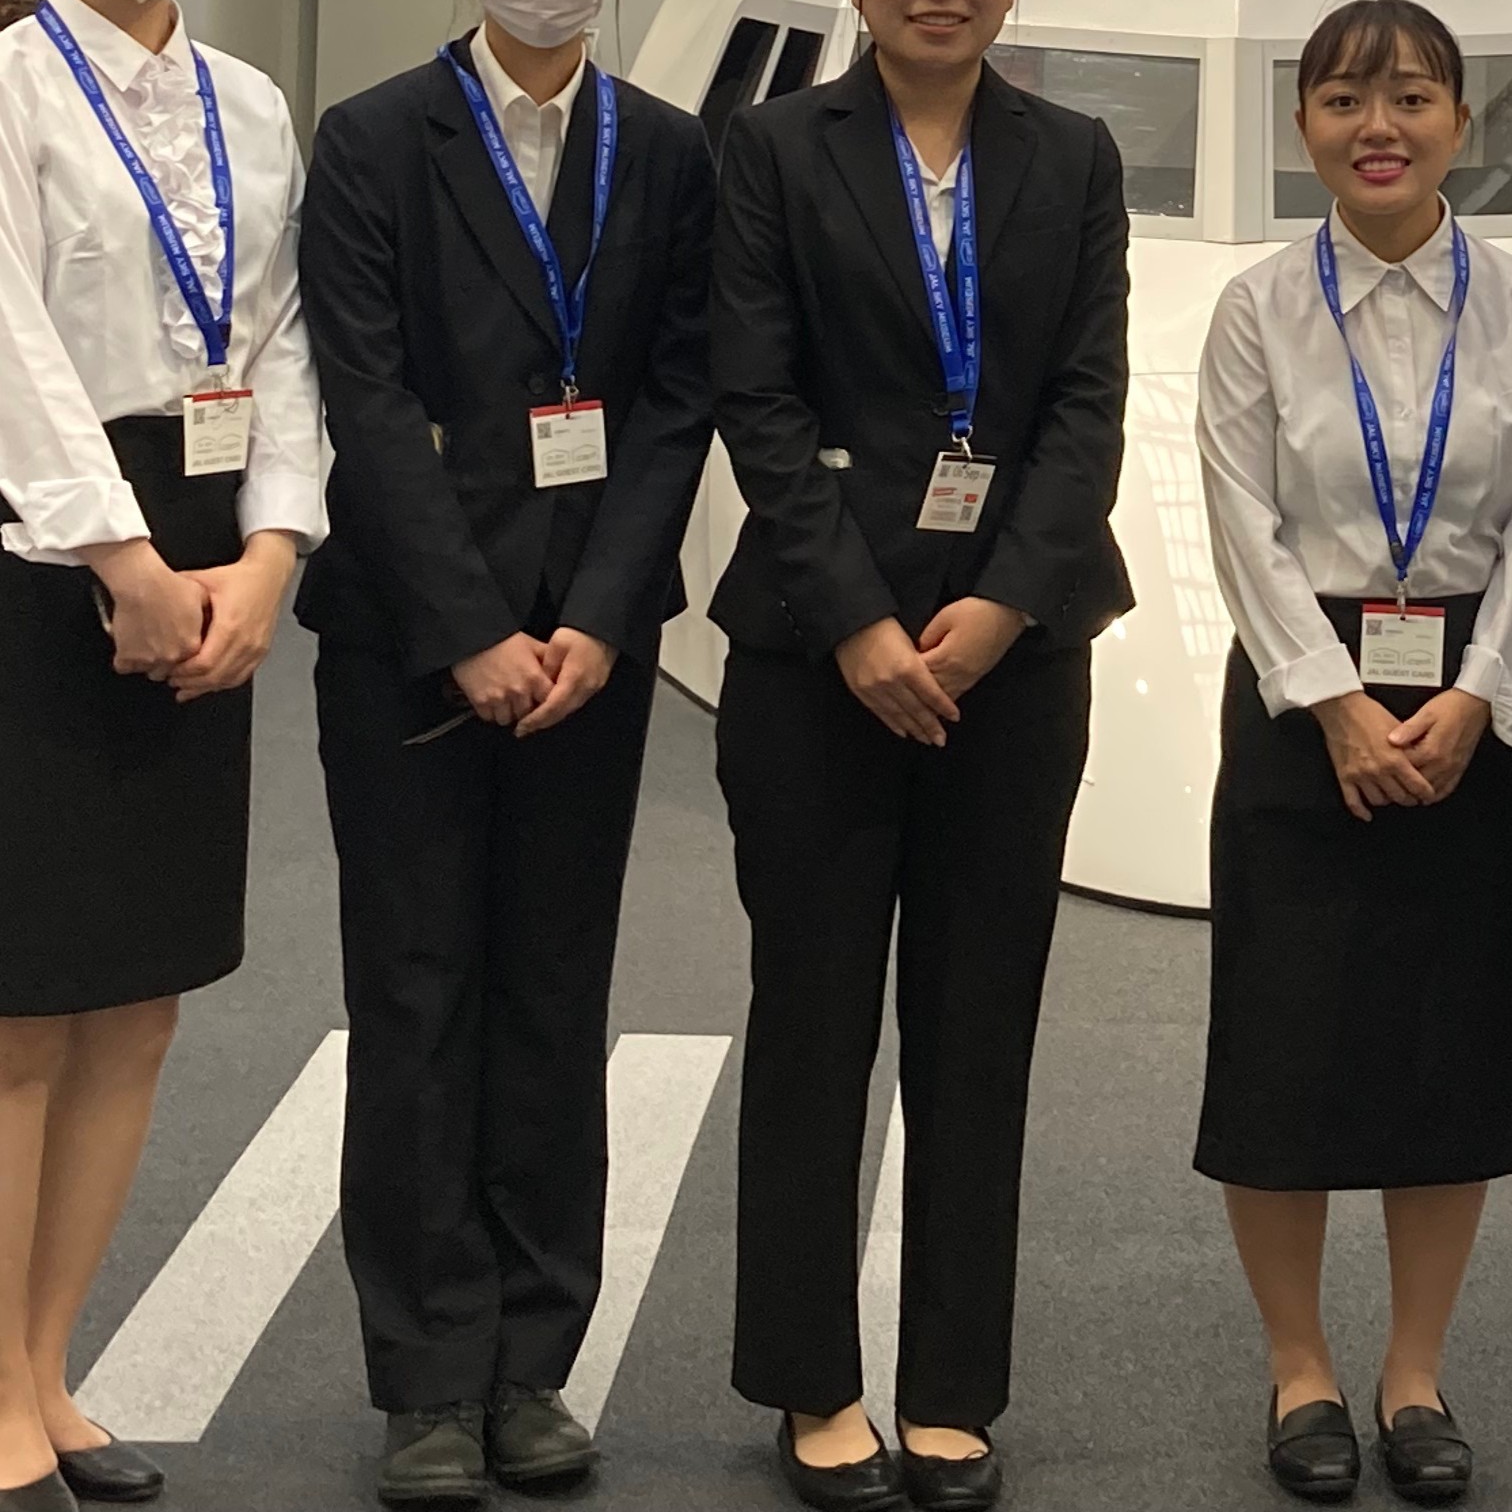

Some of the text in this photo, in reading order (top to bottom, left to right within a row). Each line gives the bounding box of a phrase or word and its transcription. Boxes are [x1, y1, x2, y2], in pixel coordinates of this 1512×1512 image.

[98, 102, 146, 175] JAL SKY MUSEUM
[480, 110, 519, 184] JAL SKY MUSEUM
[599, 111, 611, 186] JAL SKY MUSEUM
[904, 161, 926, 236] JAL SKY MUSEUM
[962, 200, 970, 218] SKY
[963, 219, 971, 236] JAL
[158, 213, 199, 293] JAL SKY MUSEUM
[528, 223, 550, 262] MUSEUM
[929, 273, 952, 354] JAL SKY MUSEUM
[965, 276, 974, 317] MUSEUM
[967, 341, 975, 358] JAL
[1366, 423, 1388, 504] JAL SKY MUSEUM
[1420, 426, 1442, 508] JAL SKY MUSEUM
[1382, 669, 1410, 677] GUEST
[1411, 671, 1436, 679] CARD
